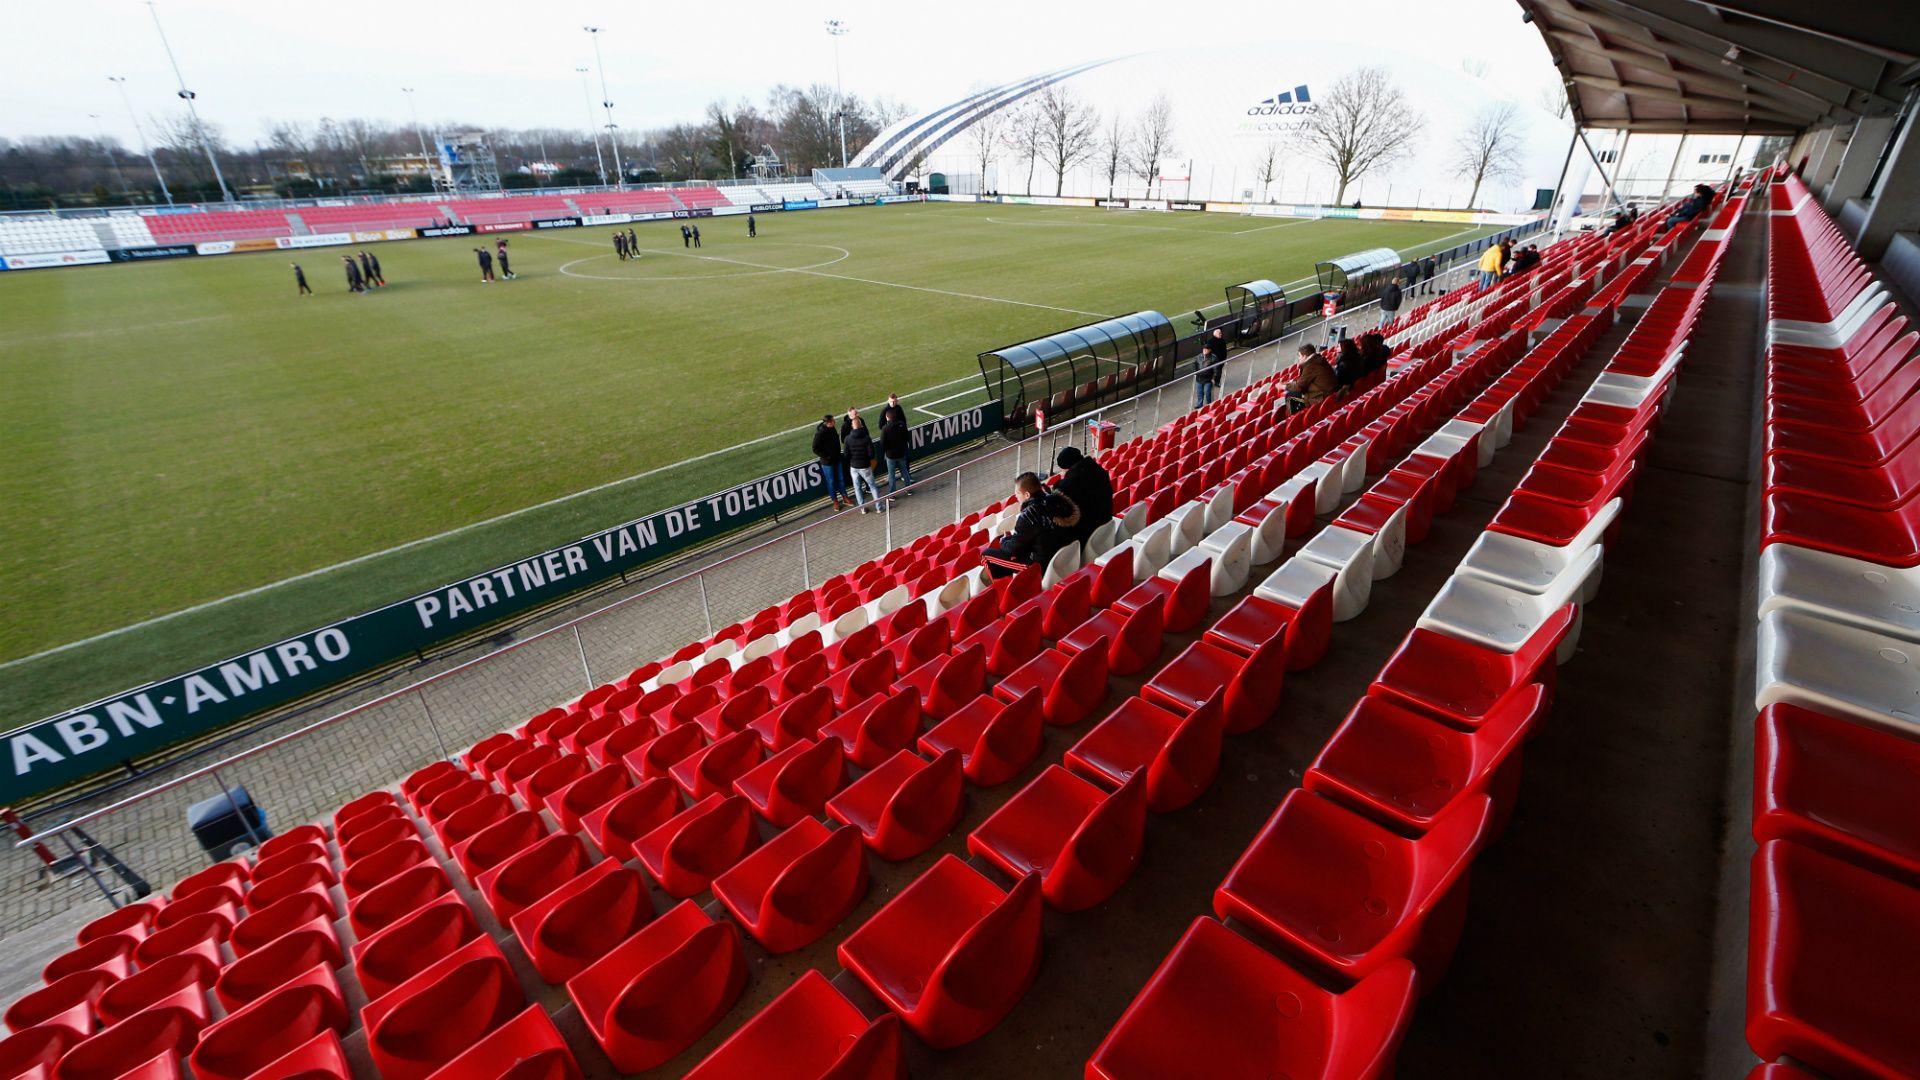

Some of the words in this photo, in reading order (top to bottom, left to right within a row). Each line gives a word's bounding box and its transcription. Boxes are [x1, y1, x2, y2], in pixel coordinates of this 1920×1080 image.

[1247, 103, 1319, 116] adidas
[441, 226, 470, 235] adidas
[414, 546, 589, 629] PARTNER
[592, 518, 659, 563] VAN
[664, 504, 702, 539] DE
[706, 461, 823, 523] TOEKOMS
